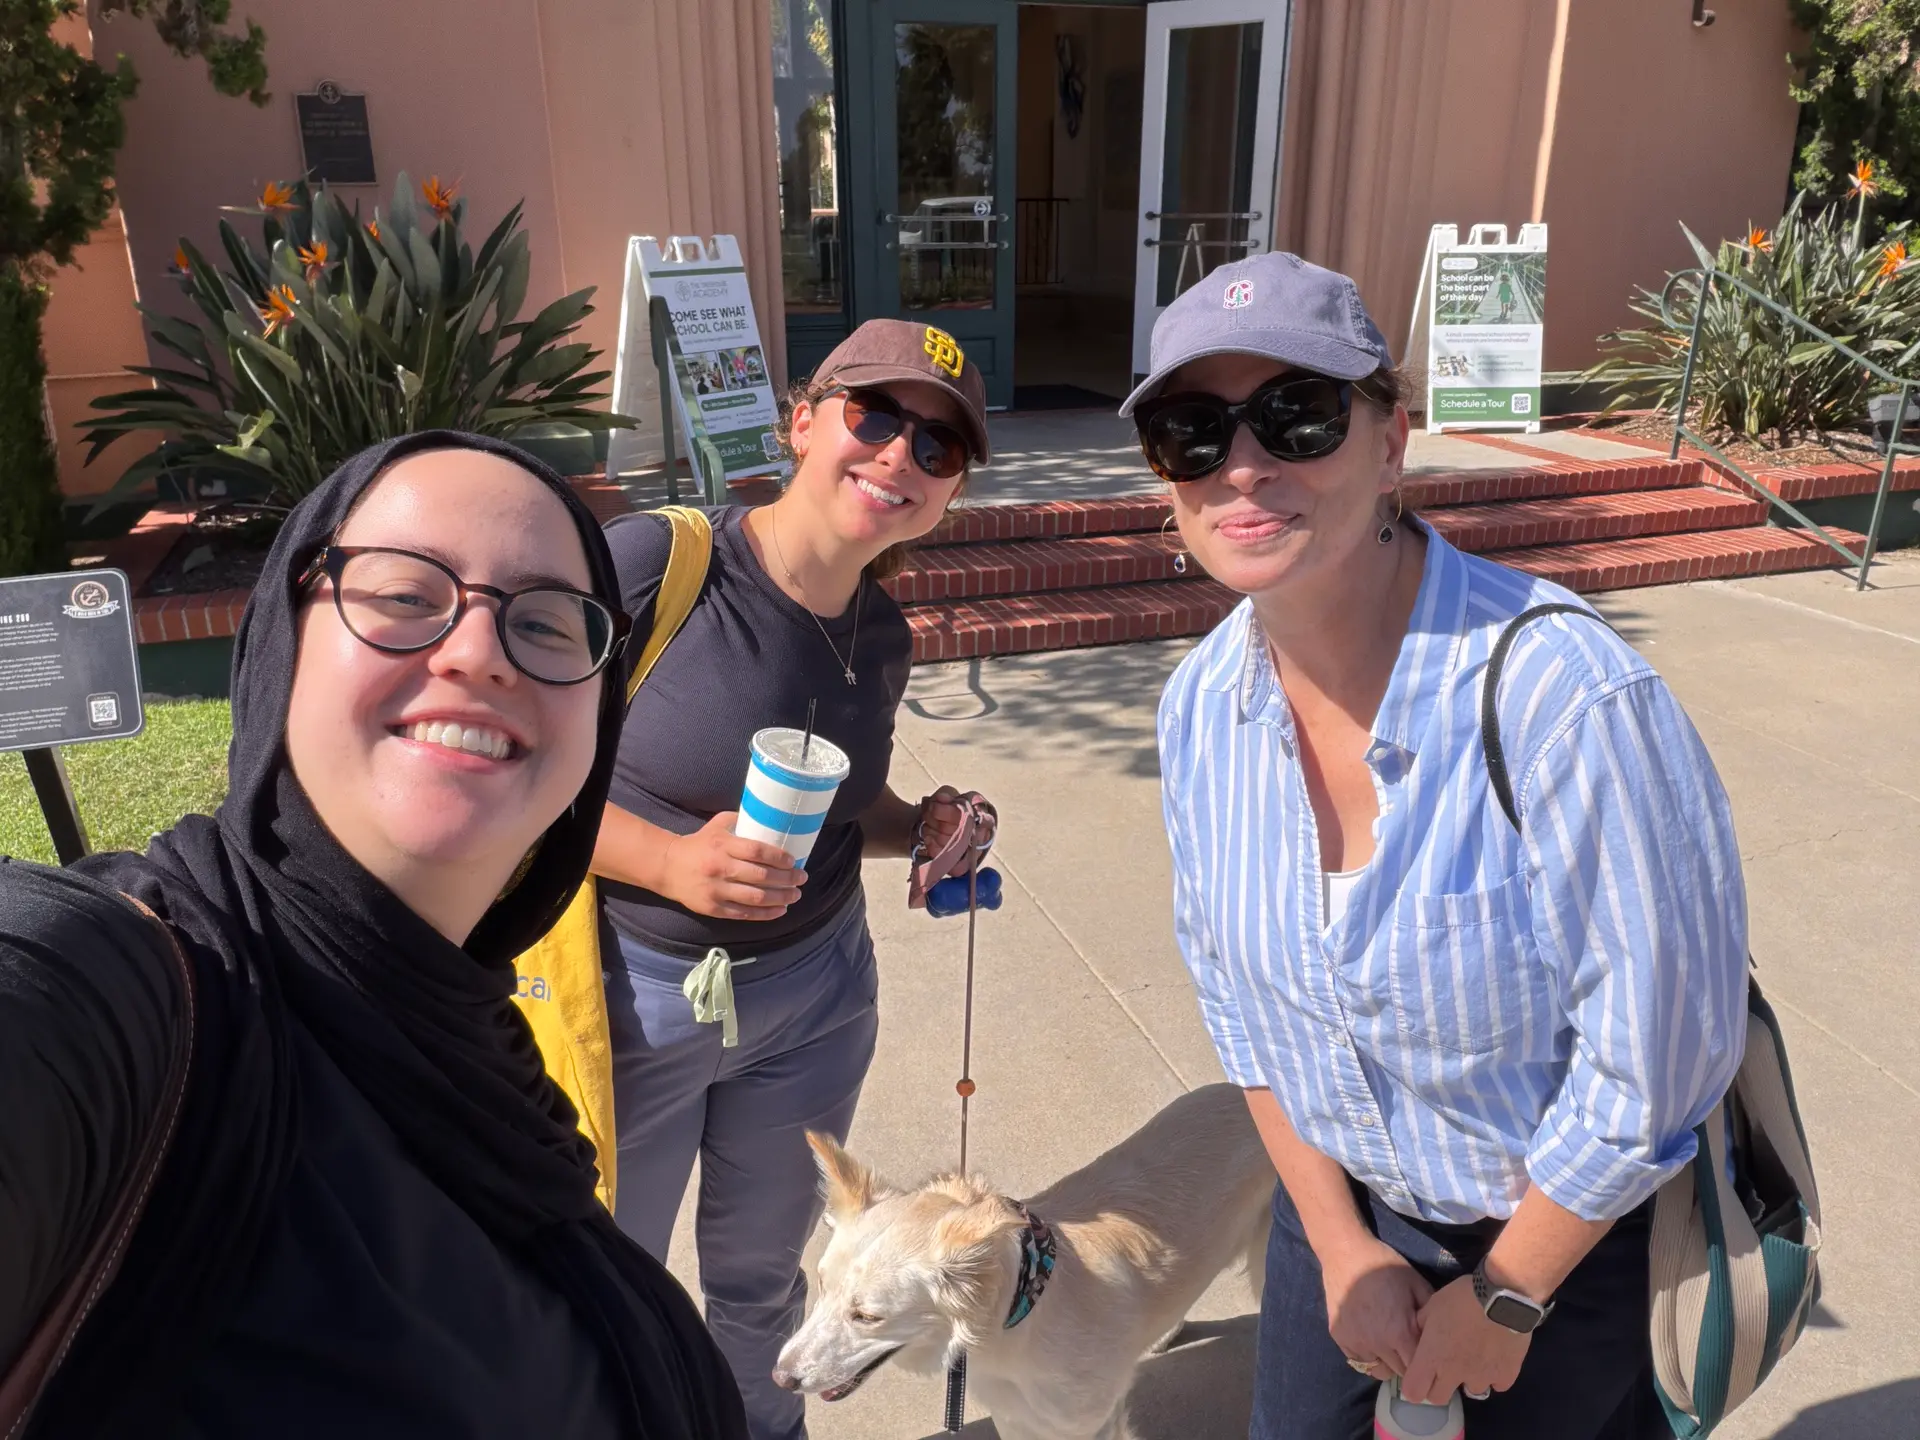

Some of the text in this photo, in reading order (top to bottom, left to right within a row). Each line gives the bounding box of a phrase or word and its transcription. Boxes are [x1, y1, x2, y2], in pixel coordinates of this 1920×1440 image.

[1441, 274, 1468, 282] School
[1484, 274, 1494, 282] be
[1473, 284, 1490, 292] part
[1440, 293, 1484, 302] of their day
[670, 306, 747, 323] COME SEE WHAT
[676, 323, 712, 336] CHOOL
[713, 321, 733, 332] CAN
[1440, 399, 1480, 408] Schedule
[1487, 399, 1506, 408] Tour
[720, 446, 737, 457] dule
[741, 443, 758, 453] Tour
